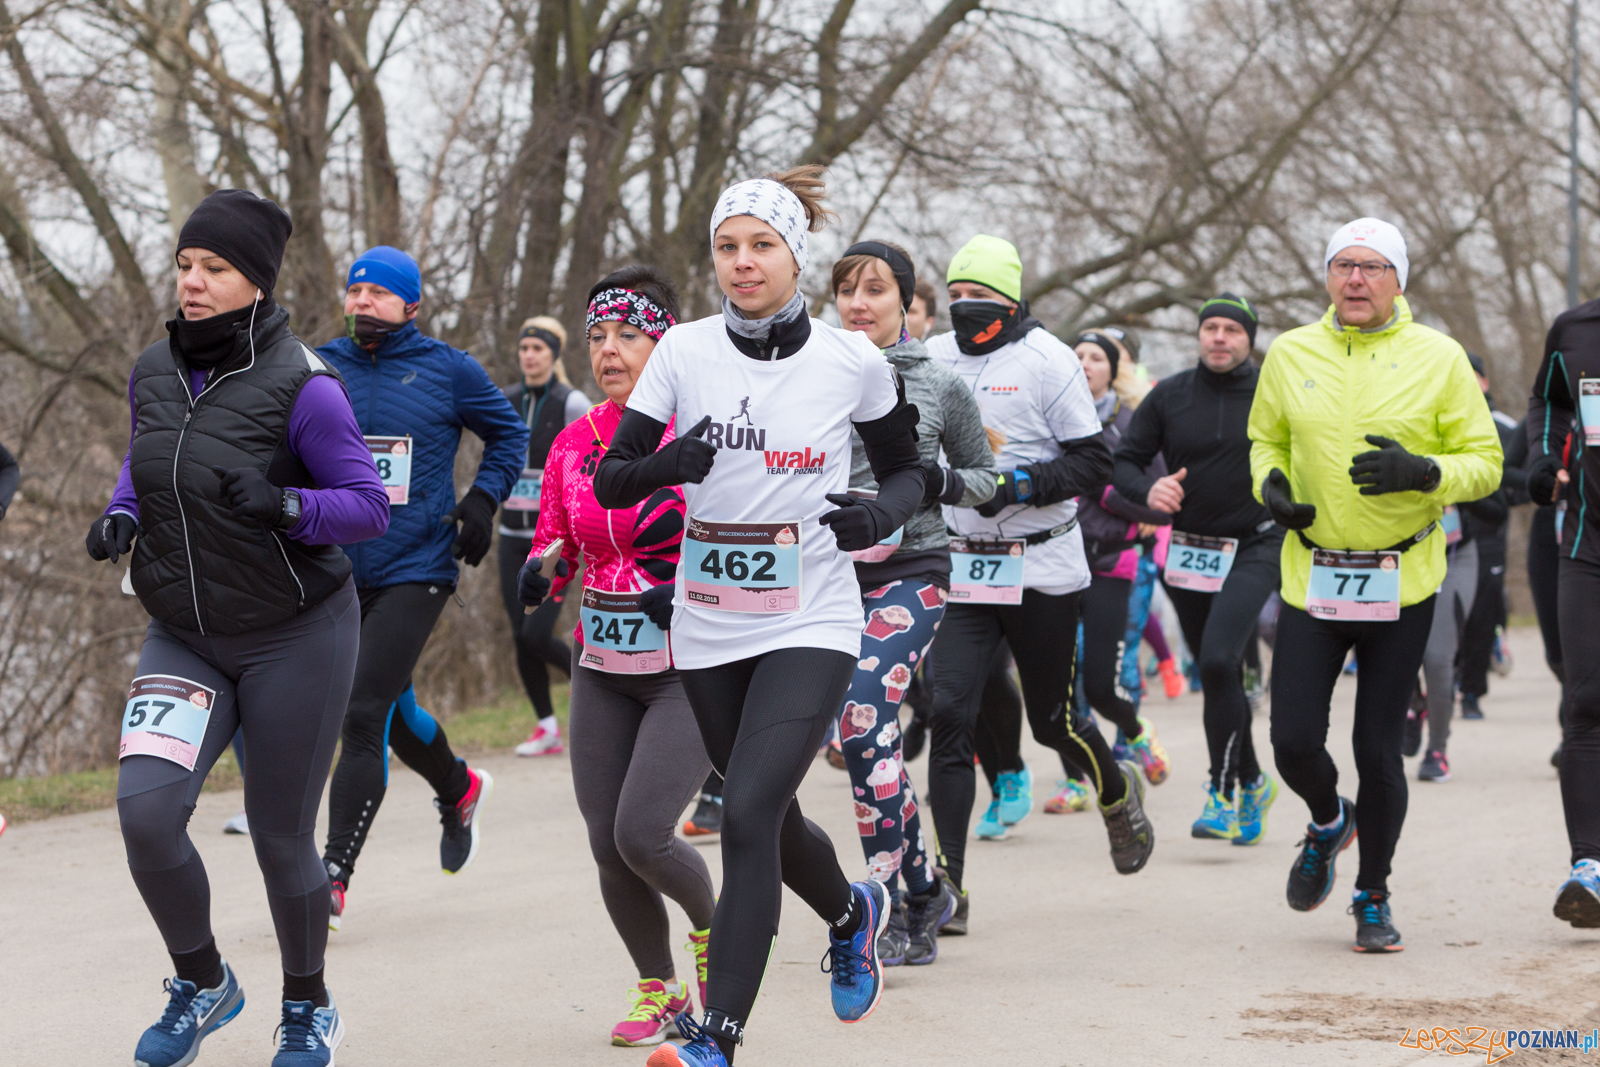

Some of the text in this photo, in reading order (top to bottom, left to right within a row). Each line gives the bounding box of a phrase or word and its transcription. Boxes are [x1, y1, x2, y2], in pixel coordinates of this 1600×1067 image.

[706, 422, 766, 451] RUN
[766, 467, 789, 475] TEAM
[700, 549, 777, 581] 462
[969, 559, 1002, 580] 87
[1179, 550, 1221, 573] 254
[1334, 573, 1371, 596] 77
[689, 592, 718, 603] 11.02.2018
[591, 615, 644, 645] 247
[128, 700, 176, 728] 57
